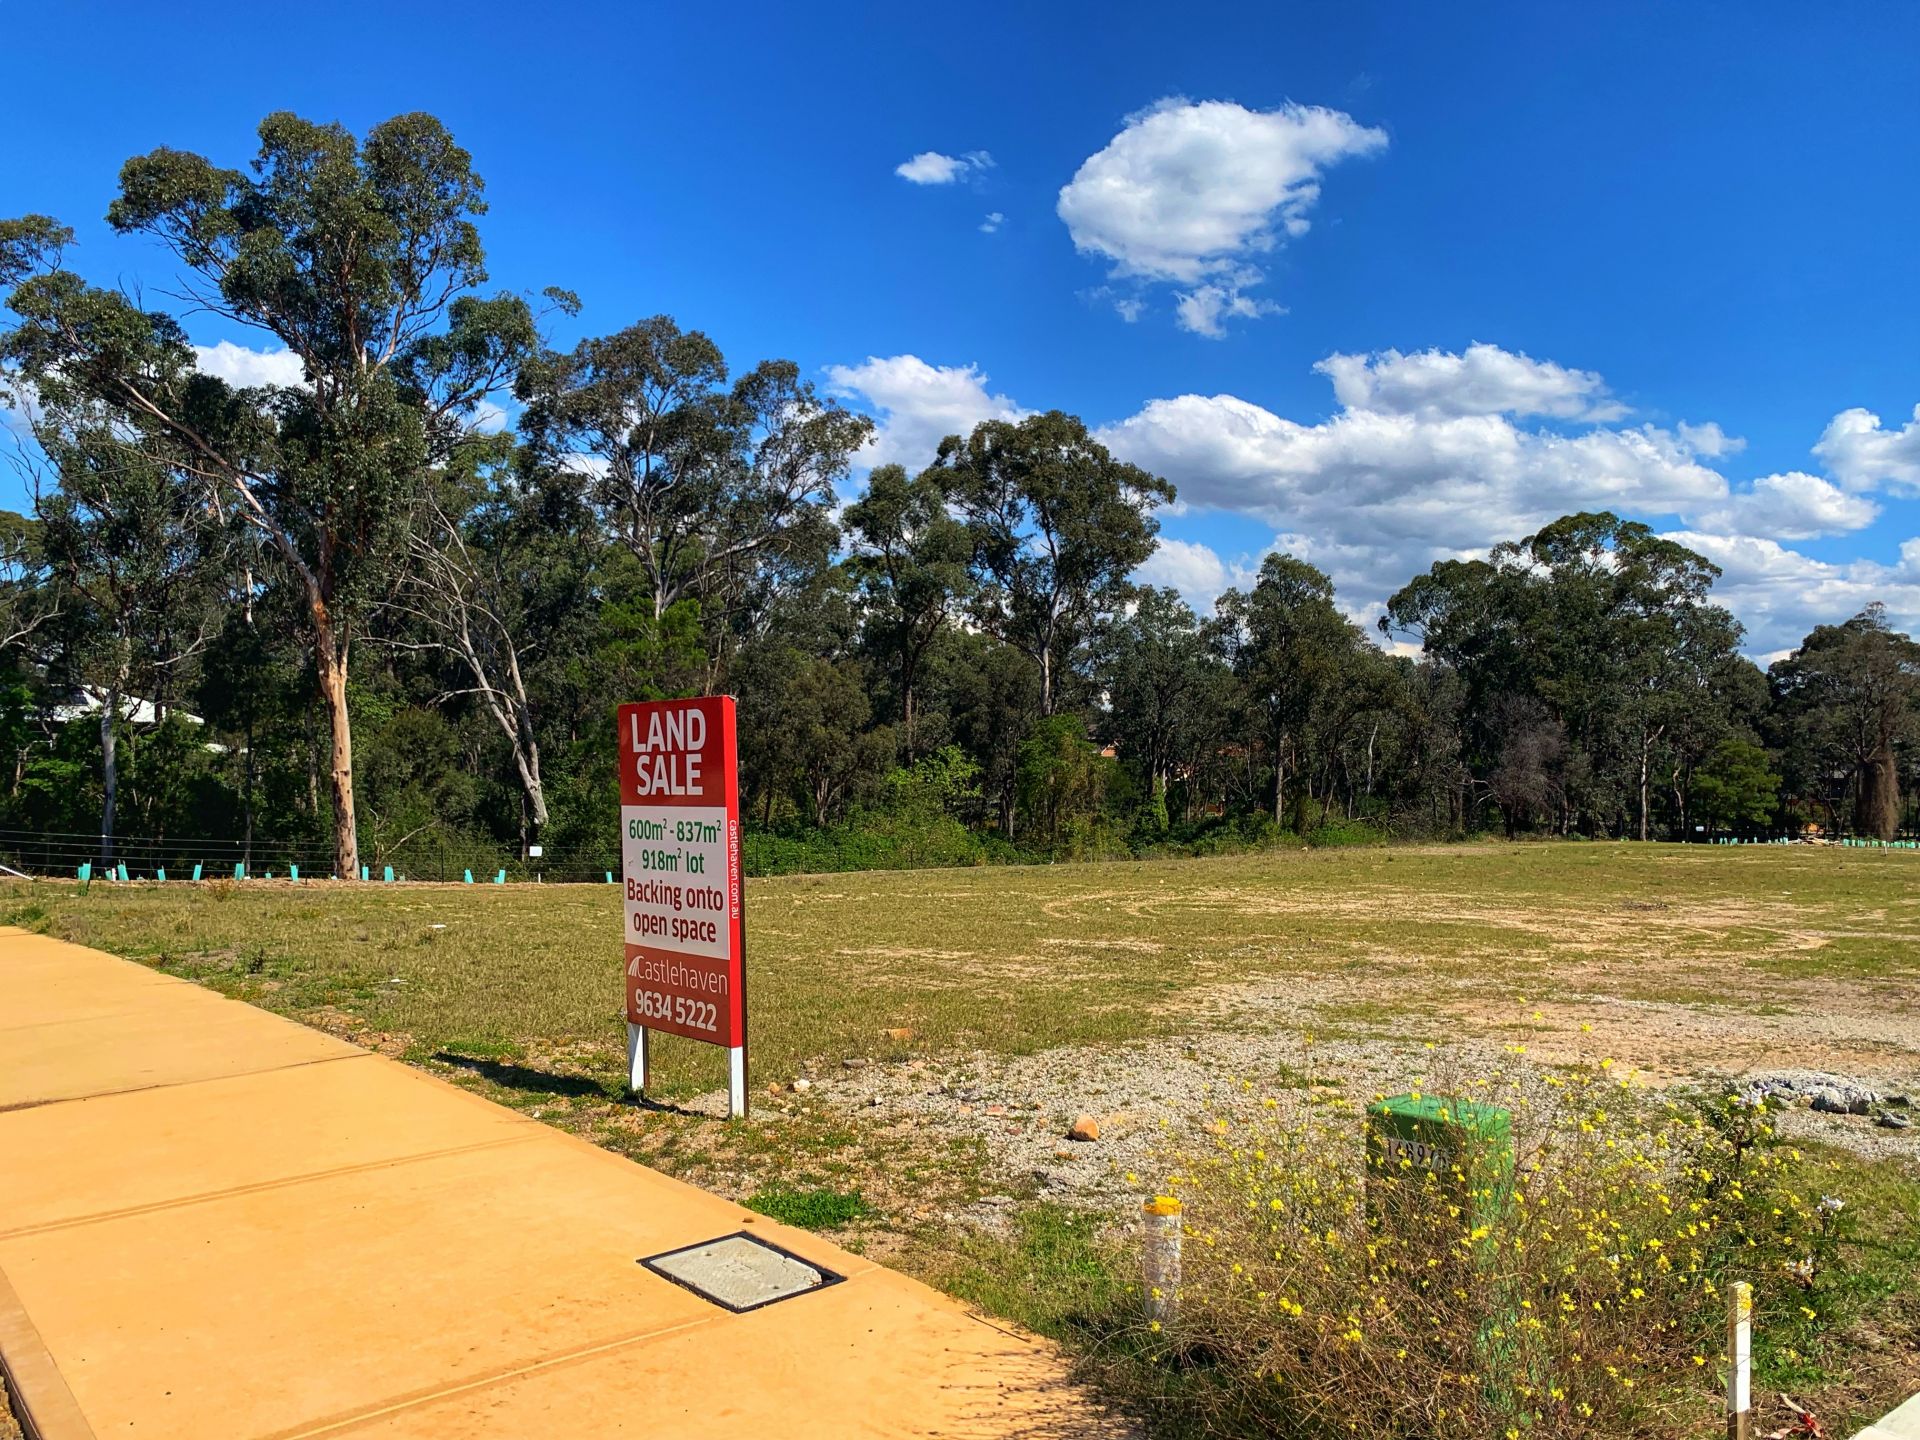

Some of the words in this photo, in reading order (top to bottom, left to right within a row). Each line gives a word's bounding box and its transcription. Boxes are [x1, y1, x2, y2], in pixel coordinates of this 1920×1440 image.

[631, 708, 707, 753] LAND
[636, 753, 704, 796] SALE
[629, 818, 668, 841] 600m²
[676, 820, 722, 843] 837m²
[642, 847, 682, 872] 918m²
[686, 851, 705, 874] lot
[729, 819, 740, 919] castlehaven.com.au
[627, 878, 683, 911] Backing
[686, 885, 724, 911] onto
[633, 912, 668, 937] open
[672, 917, 717, 943] space
[628, 955, 728, 996] Castlehaven
[635, 988, 673, 1021] 9634
[675, 996, 717, 1032] 5222
